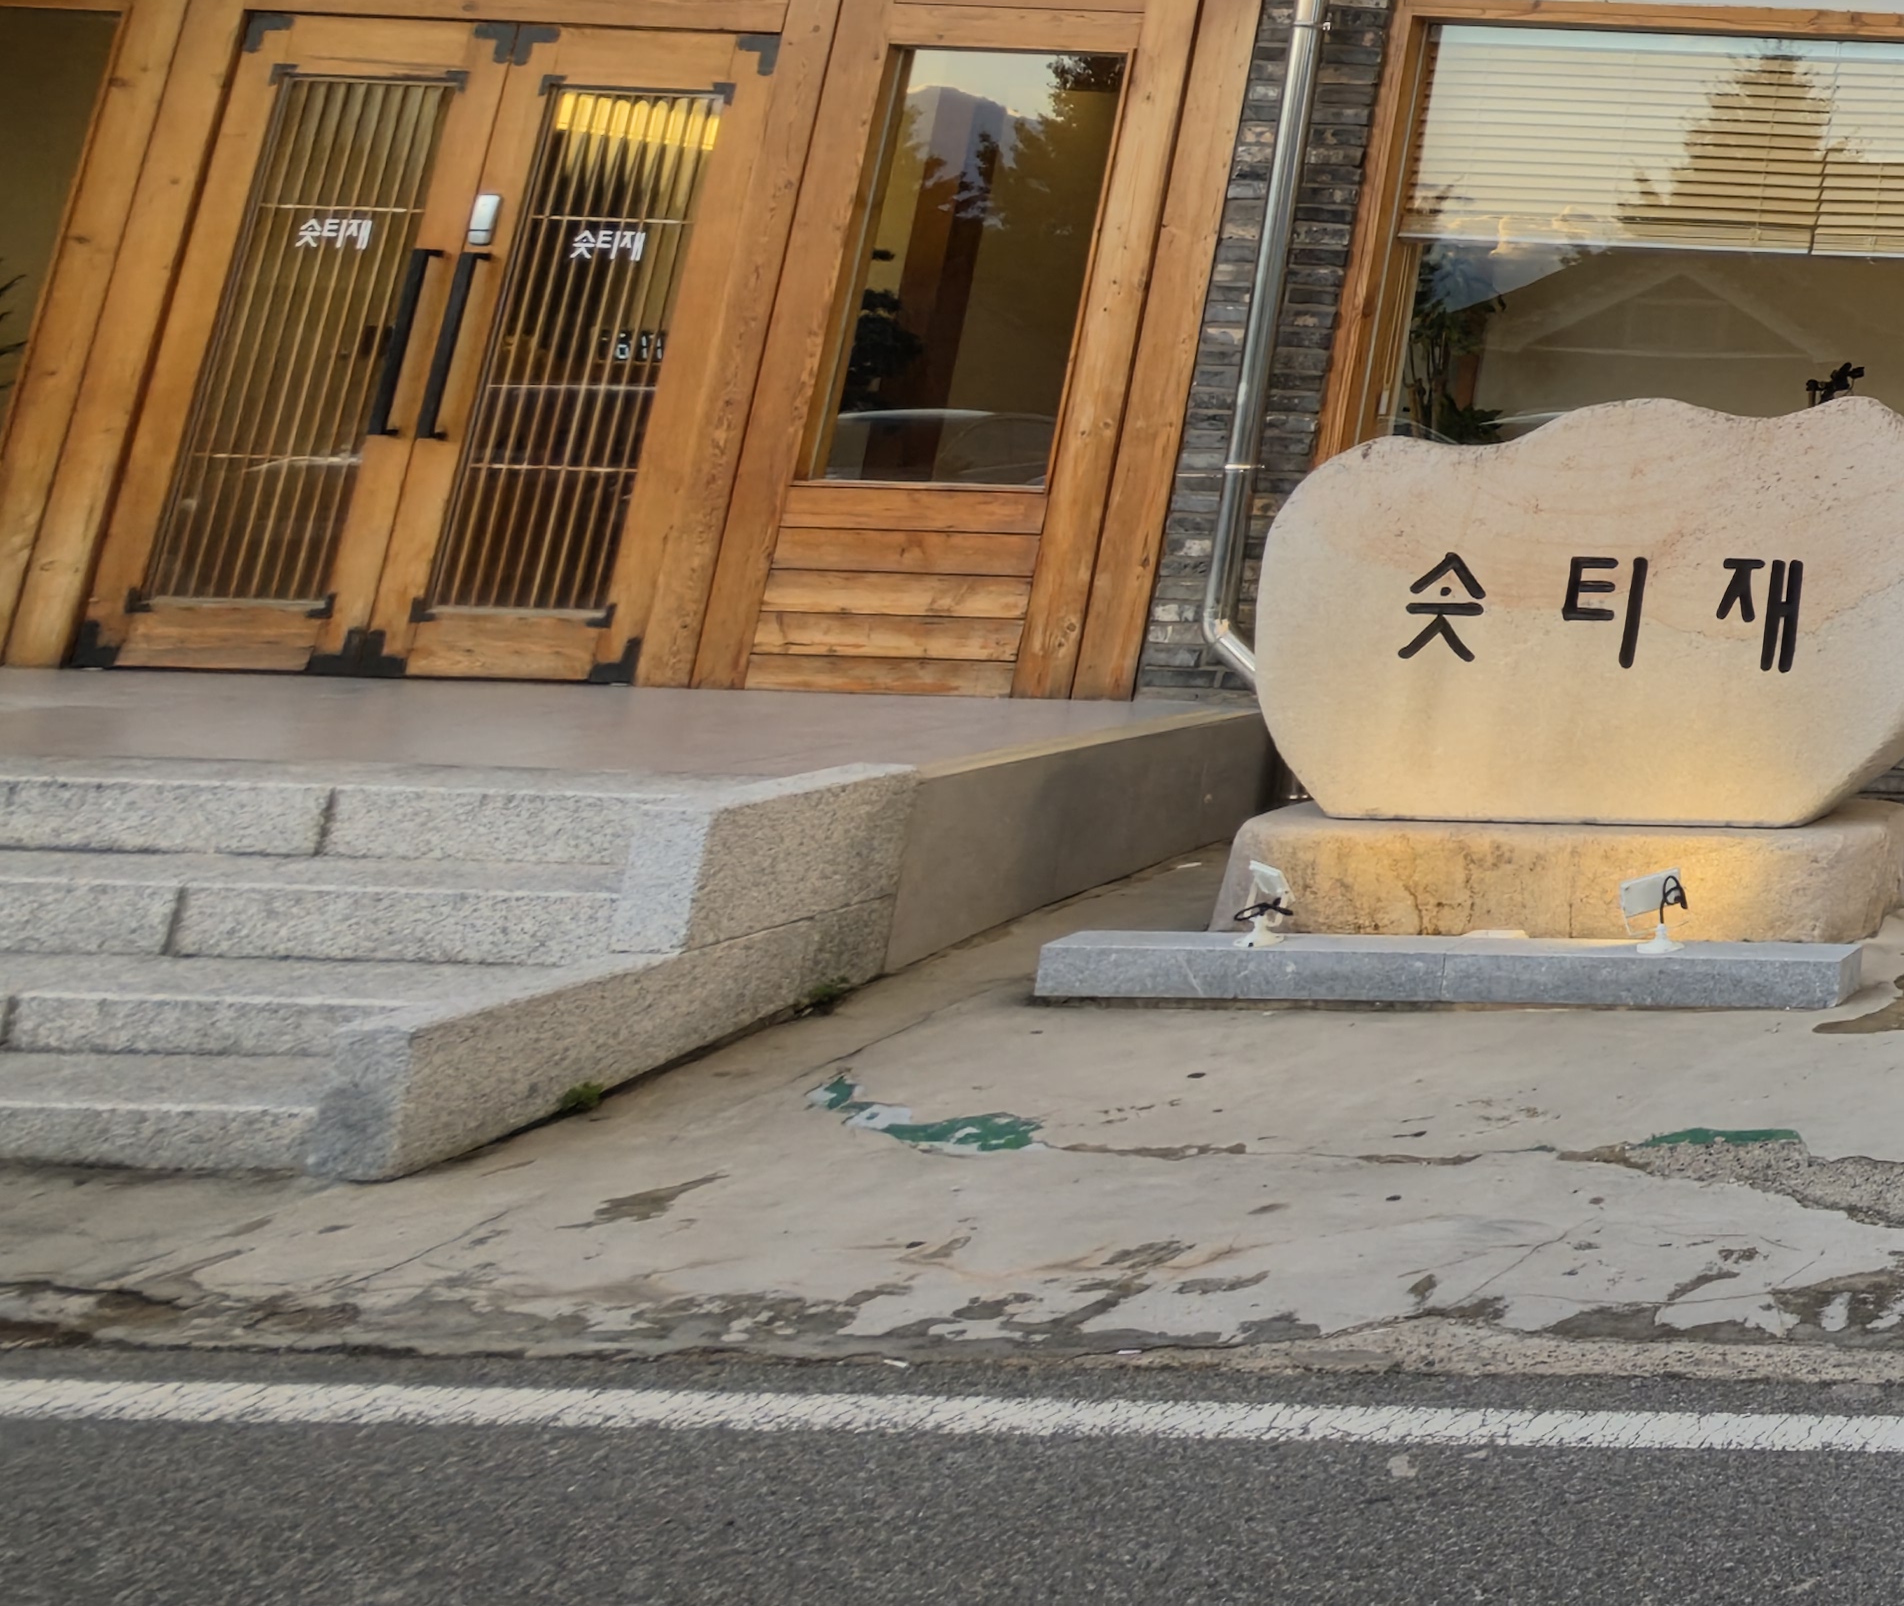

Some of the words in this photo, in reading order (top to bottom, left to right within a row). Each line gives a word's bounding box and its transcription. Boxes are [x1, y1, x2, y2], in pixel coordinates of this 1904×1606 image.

[296, 218, 372, 250] 솟티재
[570, 230, 645, 262] 솟티재
[1398, 552, 1803, 673] 솟티재
